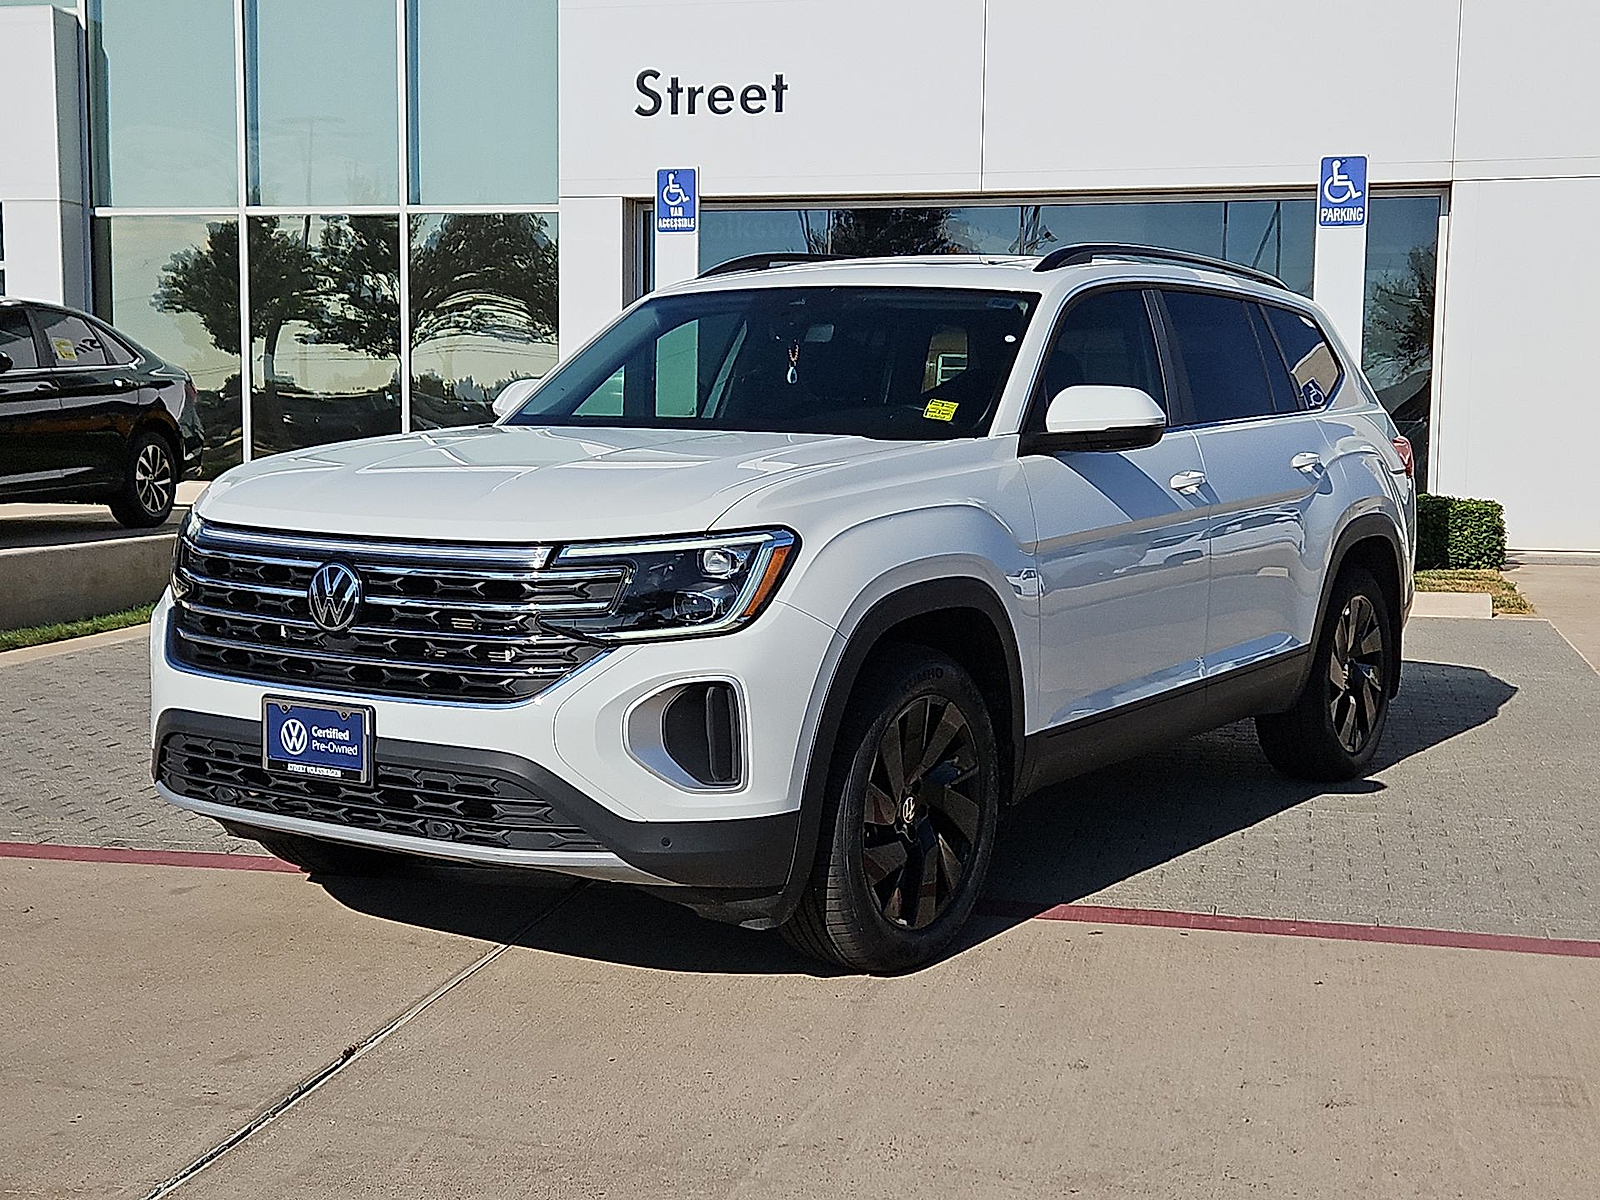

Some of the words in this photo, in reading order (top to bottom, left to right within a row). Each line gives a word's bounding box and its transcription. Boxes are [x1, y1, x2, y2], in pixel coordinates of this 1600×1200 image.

[634, 68, 789, 117] Street
[1320, 206, 1364, 222] PARKING
[658, 217, 695, 228] ACCESSIBLE
[311, 726, 350, 741] Certified
[311, 740, 358, 756] Pre-Owned
